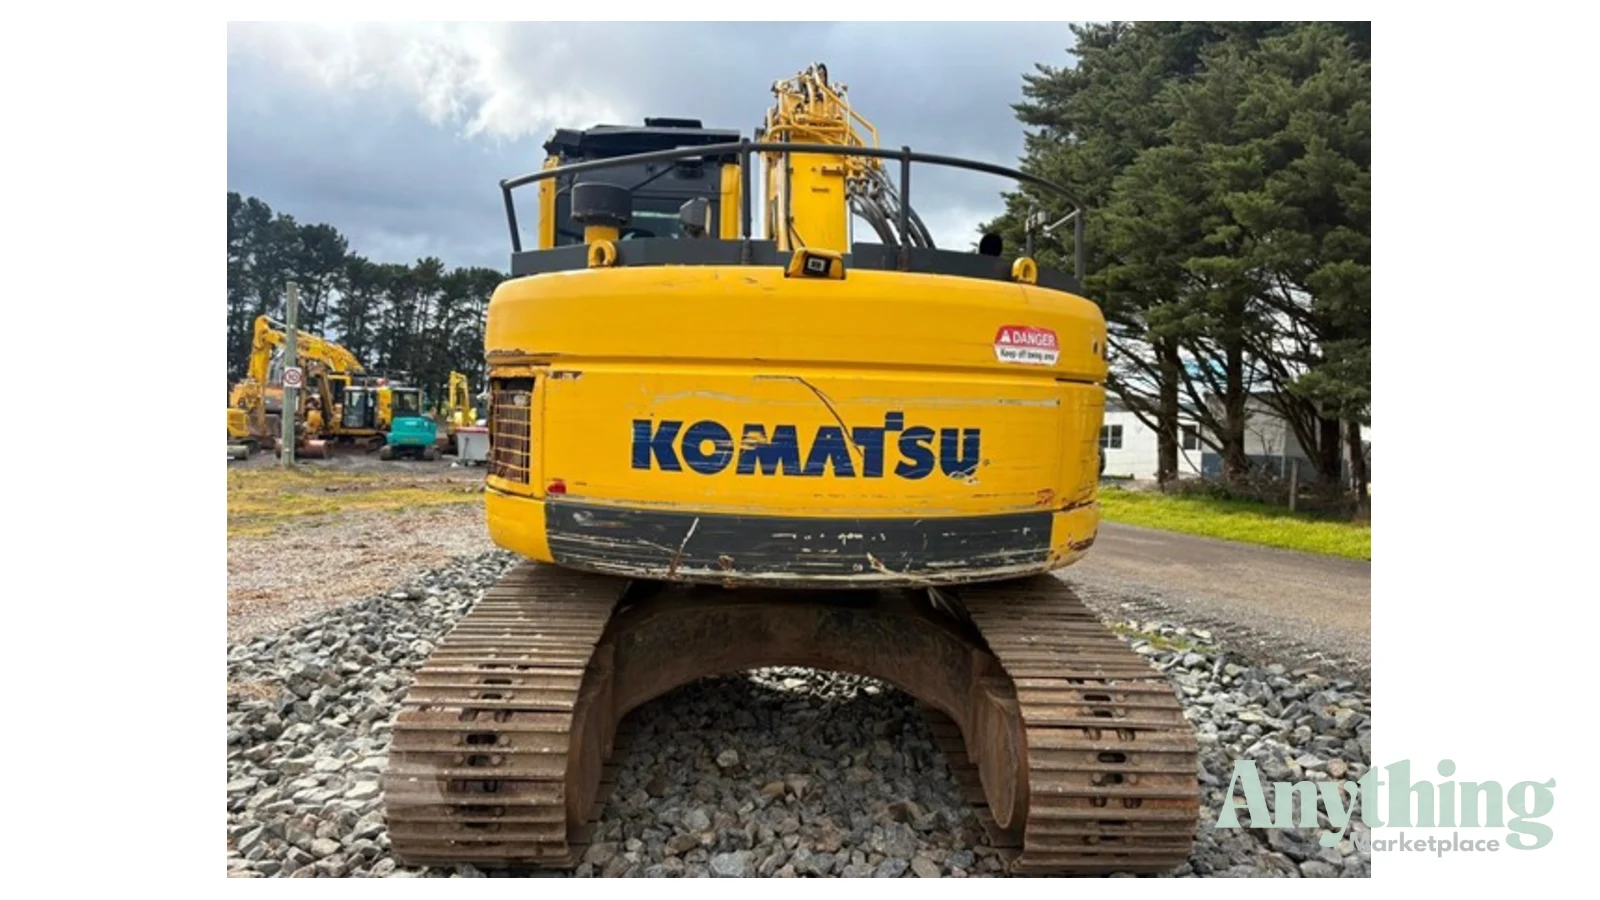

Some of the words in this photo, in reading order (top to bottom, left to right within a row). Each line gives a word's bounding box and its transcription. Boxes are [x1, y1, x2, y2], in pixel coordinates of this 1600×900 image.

[1012, 330, 1055, 347] DANGER
[1000, 349, 1016, 359] Keep
[1018, 349, 1027, 359] off
[631, 411, 981, 480] KOMATSU
